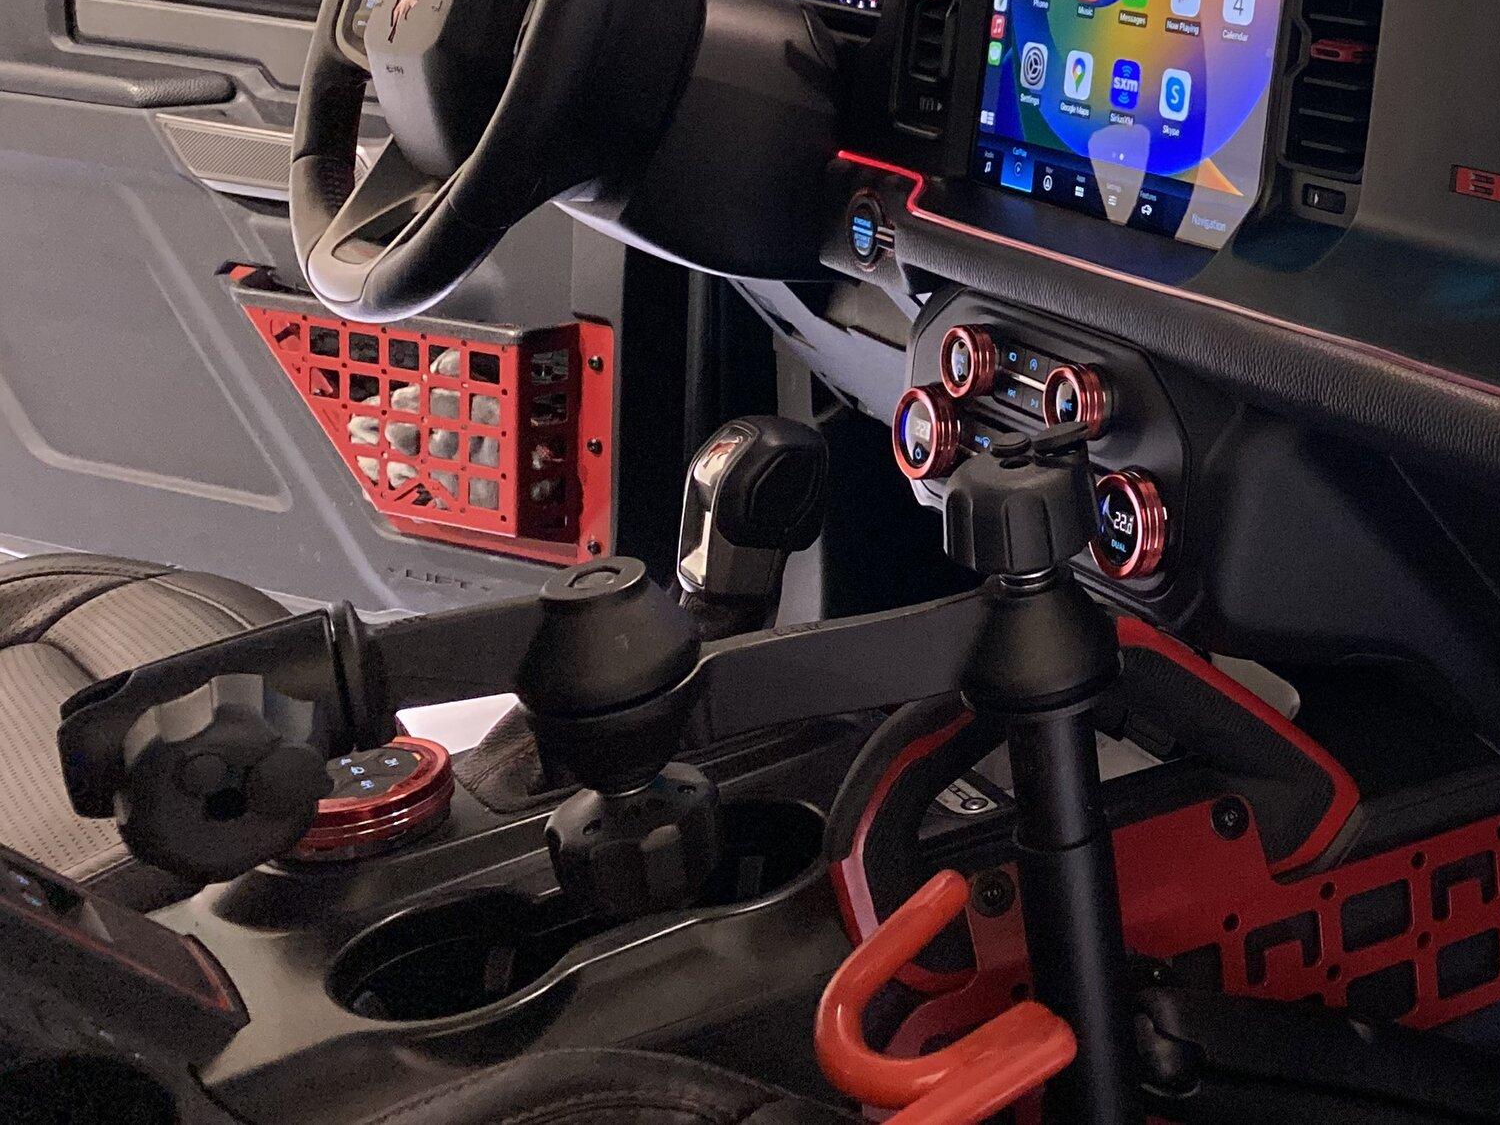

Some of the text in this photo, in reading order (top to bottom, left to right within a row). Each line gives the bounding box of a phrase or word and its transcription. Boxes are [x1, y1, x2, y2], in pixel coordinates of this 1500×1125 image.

[1077, 6, 1093, 16] Music
[1120, 13, 1146, 26] Messages
[1166, 20, 1199, 36] Now Playing
[1222, 29, 1248, 42] Calendar
[1113, 77, 1138, 93] sxm
[1020, 93, 1040, 107] Settings
[1060, 102, 1090, 117] Google Maps
[1110, 113, 1134, 125] SiriusXM
[1162, 125, 1180, 138] Skype
[1191, 213, 1226, 233] Navigation
